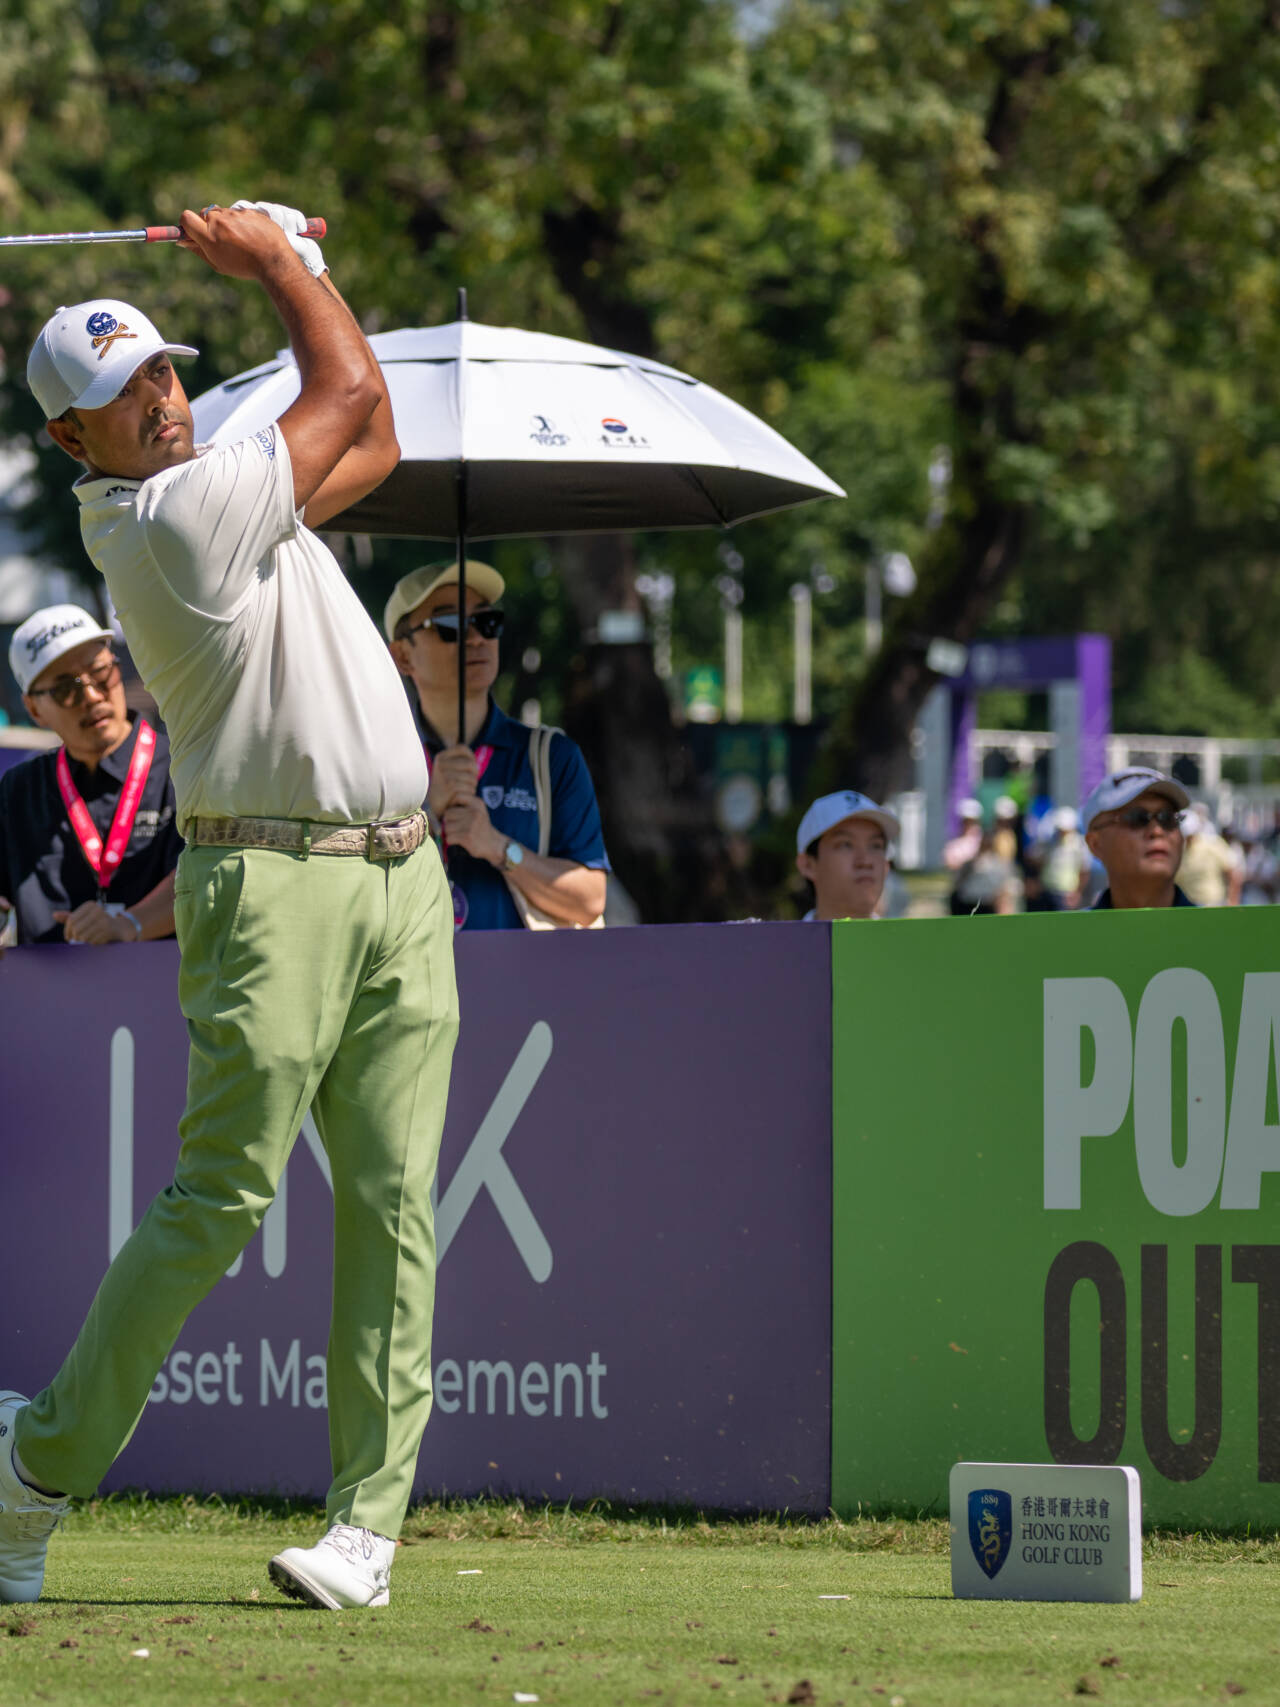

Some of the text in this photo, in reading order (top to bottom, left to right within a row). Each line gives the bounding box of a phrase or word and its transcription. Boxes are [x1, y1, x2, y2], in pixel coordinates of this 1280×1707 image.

[1042, 966, 1280, 1218] POA
[147, 1341, 244, 1406] sset
[1043, 1240, 1280, 1483] OUT
[1021, 1523, 1111, 1543] HONG KONG
[1021, 1546, 1104, 1566] GOLF CLUB
